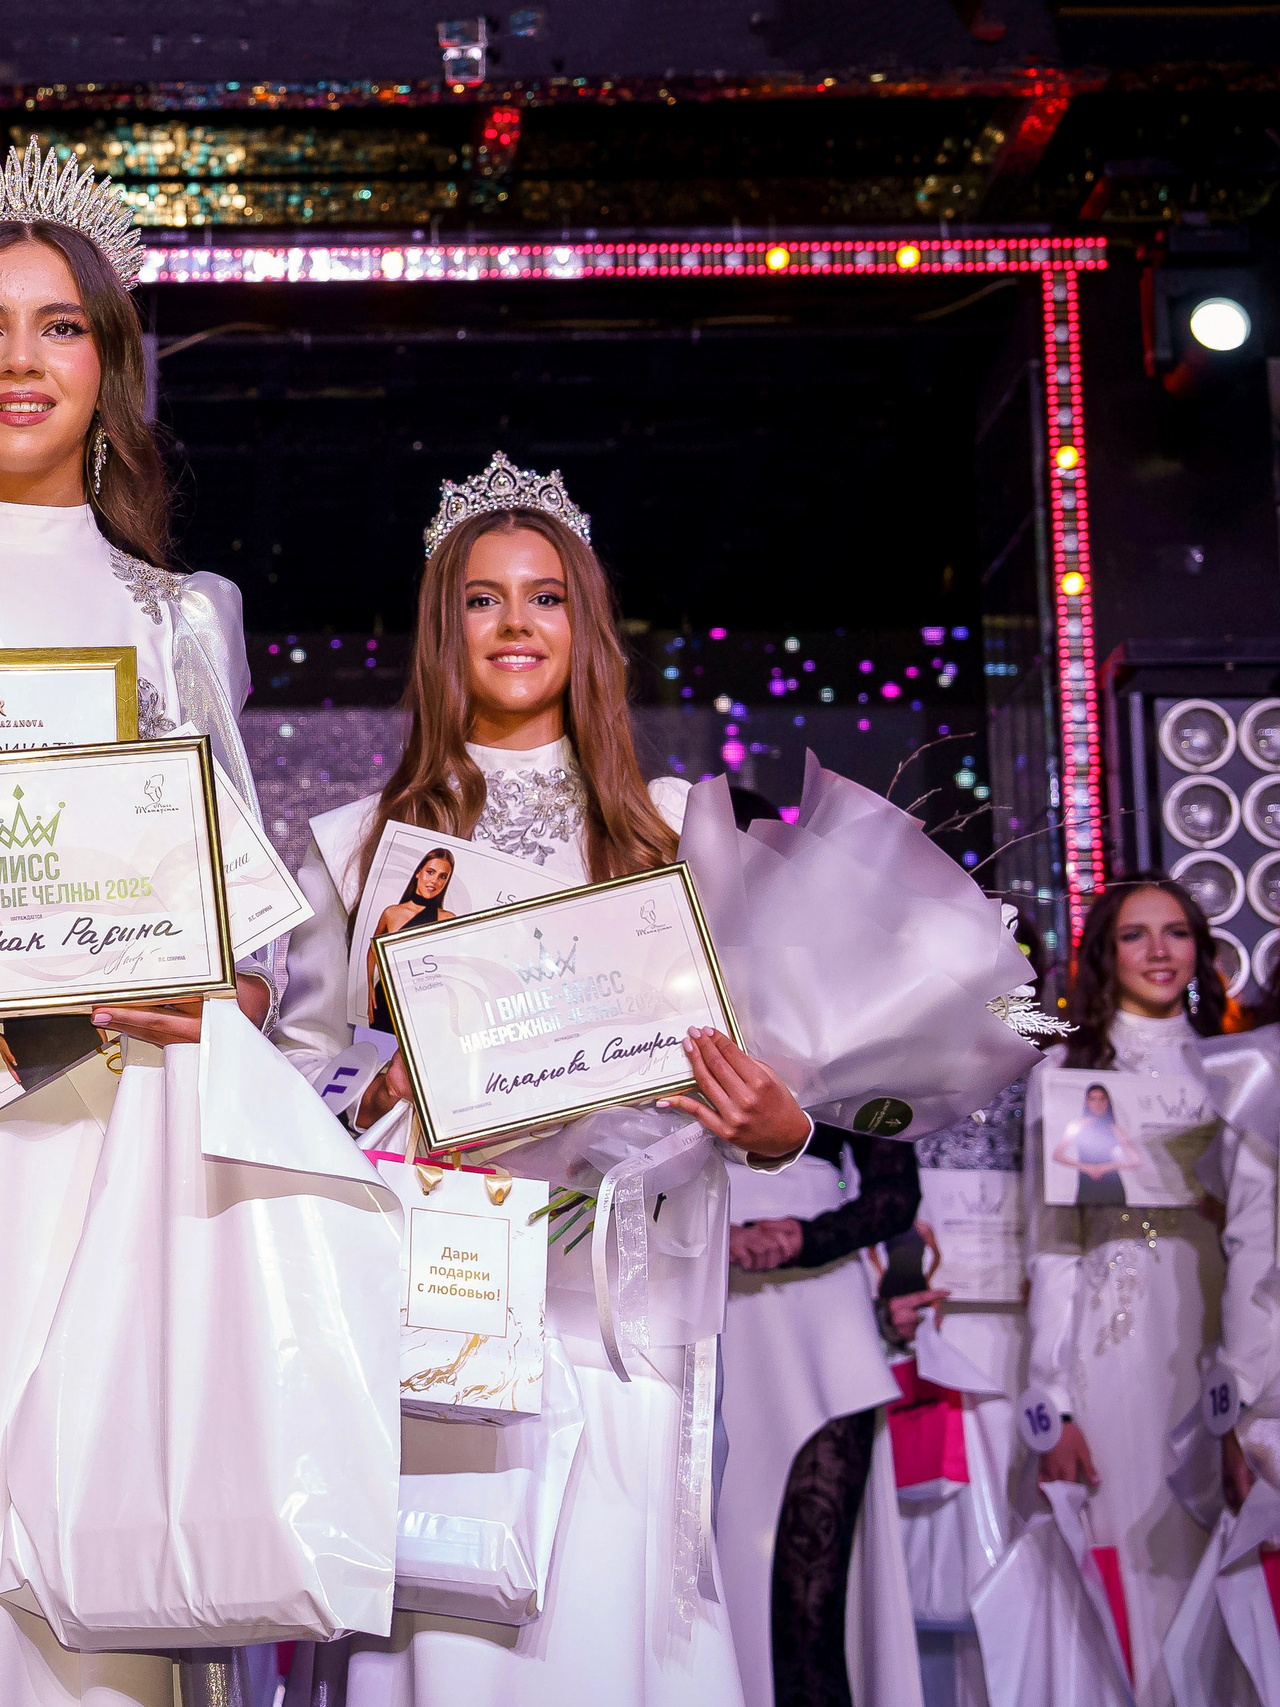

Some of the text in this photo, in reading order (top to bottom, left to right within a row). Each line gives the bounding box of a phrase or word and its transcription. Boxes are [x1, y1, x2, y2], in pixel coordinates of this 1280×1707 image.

[32, 880, 100, 906] ЧЕЛНЫ
[105, 876, 153, 900] 2025
[407, 954, 438, 977] LS
[414, 981, 444, 993] Models
[484, 1000, 496, 1026] I
[459, 1011, 566, 1054] НАБЕРЕЖНЫЕ
[440, 1246, 479, 1262] Дари
[429, 1265, 490, 1282] подарки
[417, 1281, 501, 1302] с любовью!
[1210, 1382, 1230, 1416] 18
[1025, 1402, 1052, 1436] 16
